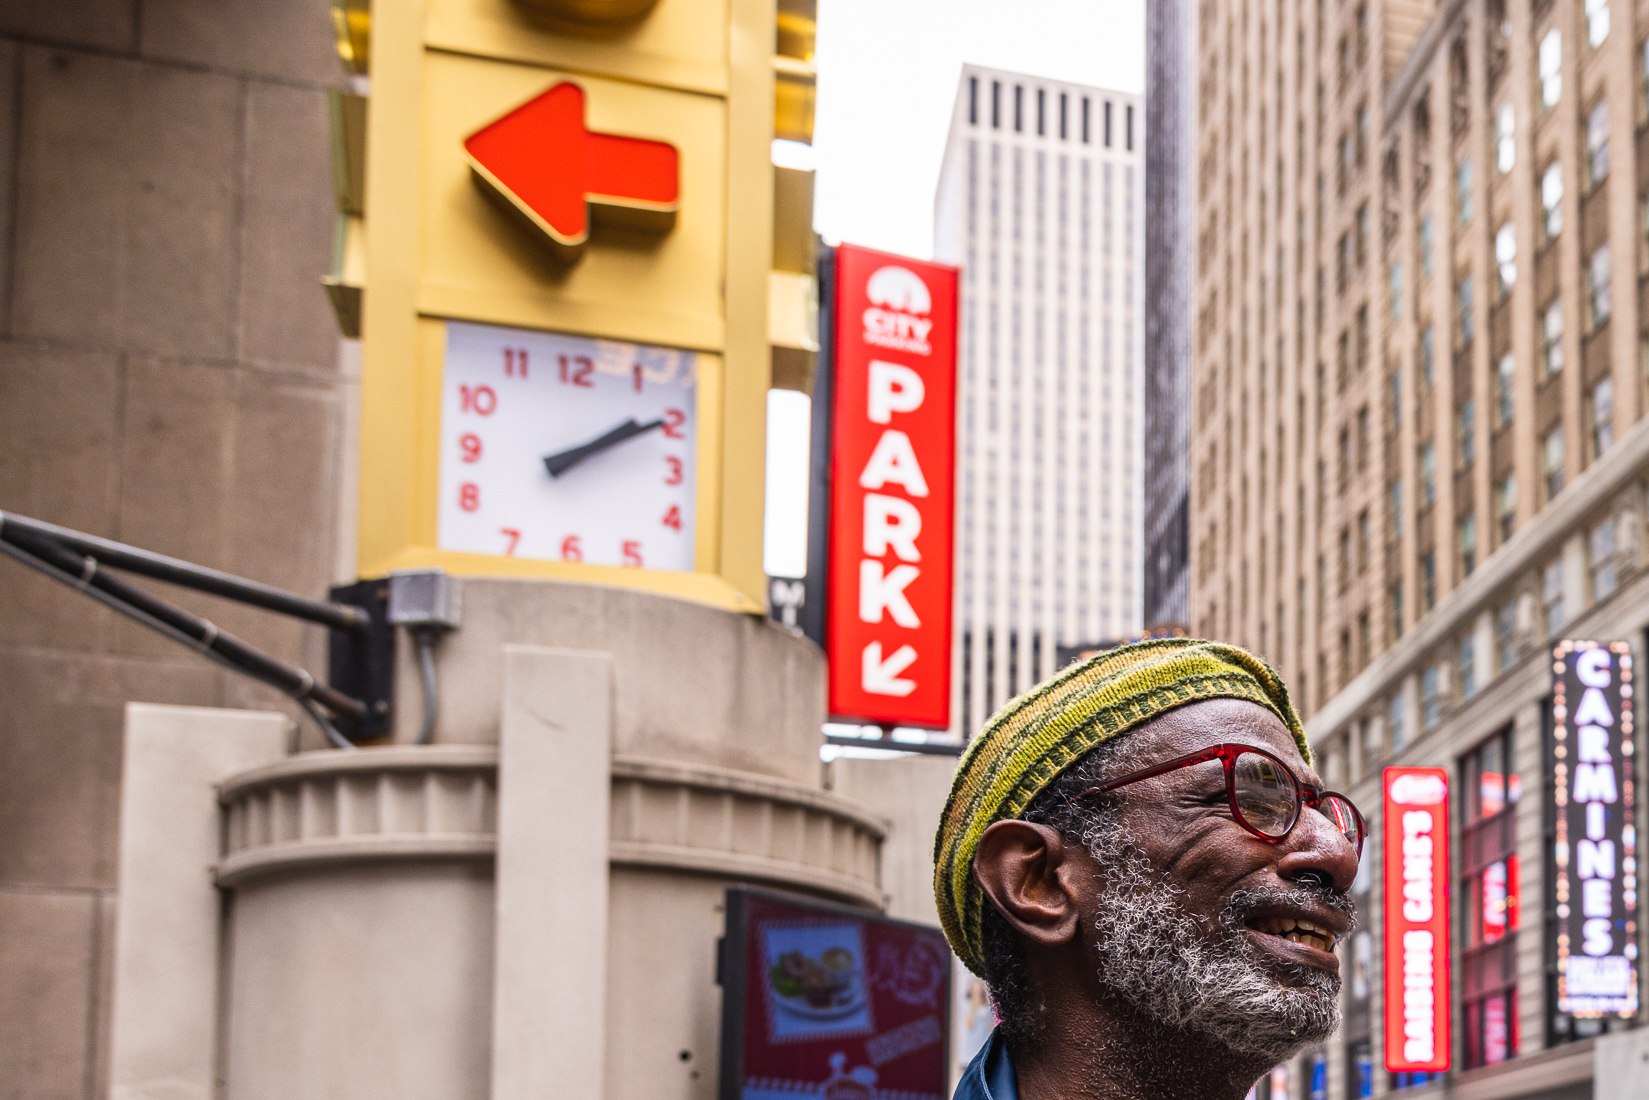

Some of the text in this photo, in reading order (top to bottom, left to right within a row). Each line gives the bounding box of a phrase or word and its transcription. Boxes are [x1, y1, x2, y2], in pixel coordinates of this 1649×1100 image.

[862, 307, 932, 341] CITY
[504, 347, 528, 380] 11
[557, 354, 595, 388] 12
[633, 363, 644, 394] 1
[459, 384, 497, 416] 10
[662, 408, 686, 439] 2
[460, 433, 482, 463] 9
[664, 455, 683, 486] 3
[459, 482, 480, 512] 8
[859, 359, 930, 629] PARK
[662, 504, 683, 532] 4
[501, 527, 521, 556] 7
[561, 534, 583, 563] 6
[622, 540, 642, 567] 5
[1403, 929, 1434, 1063] RAISING
